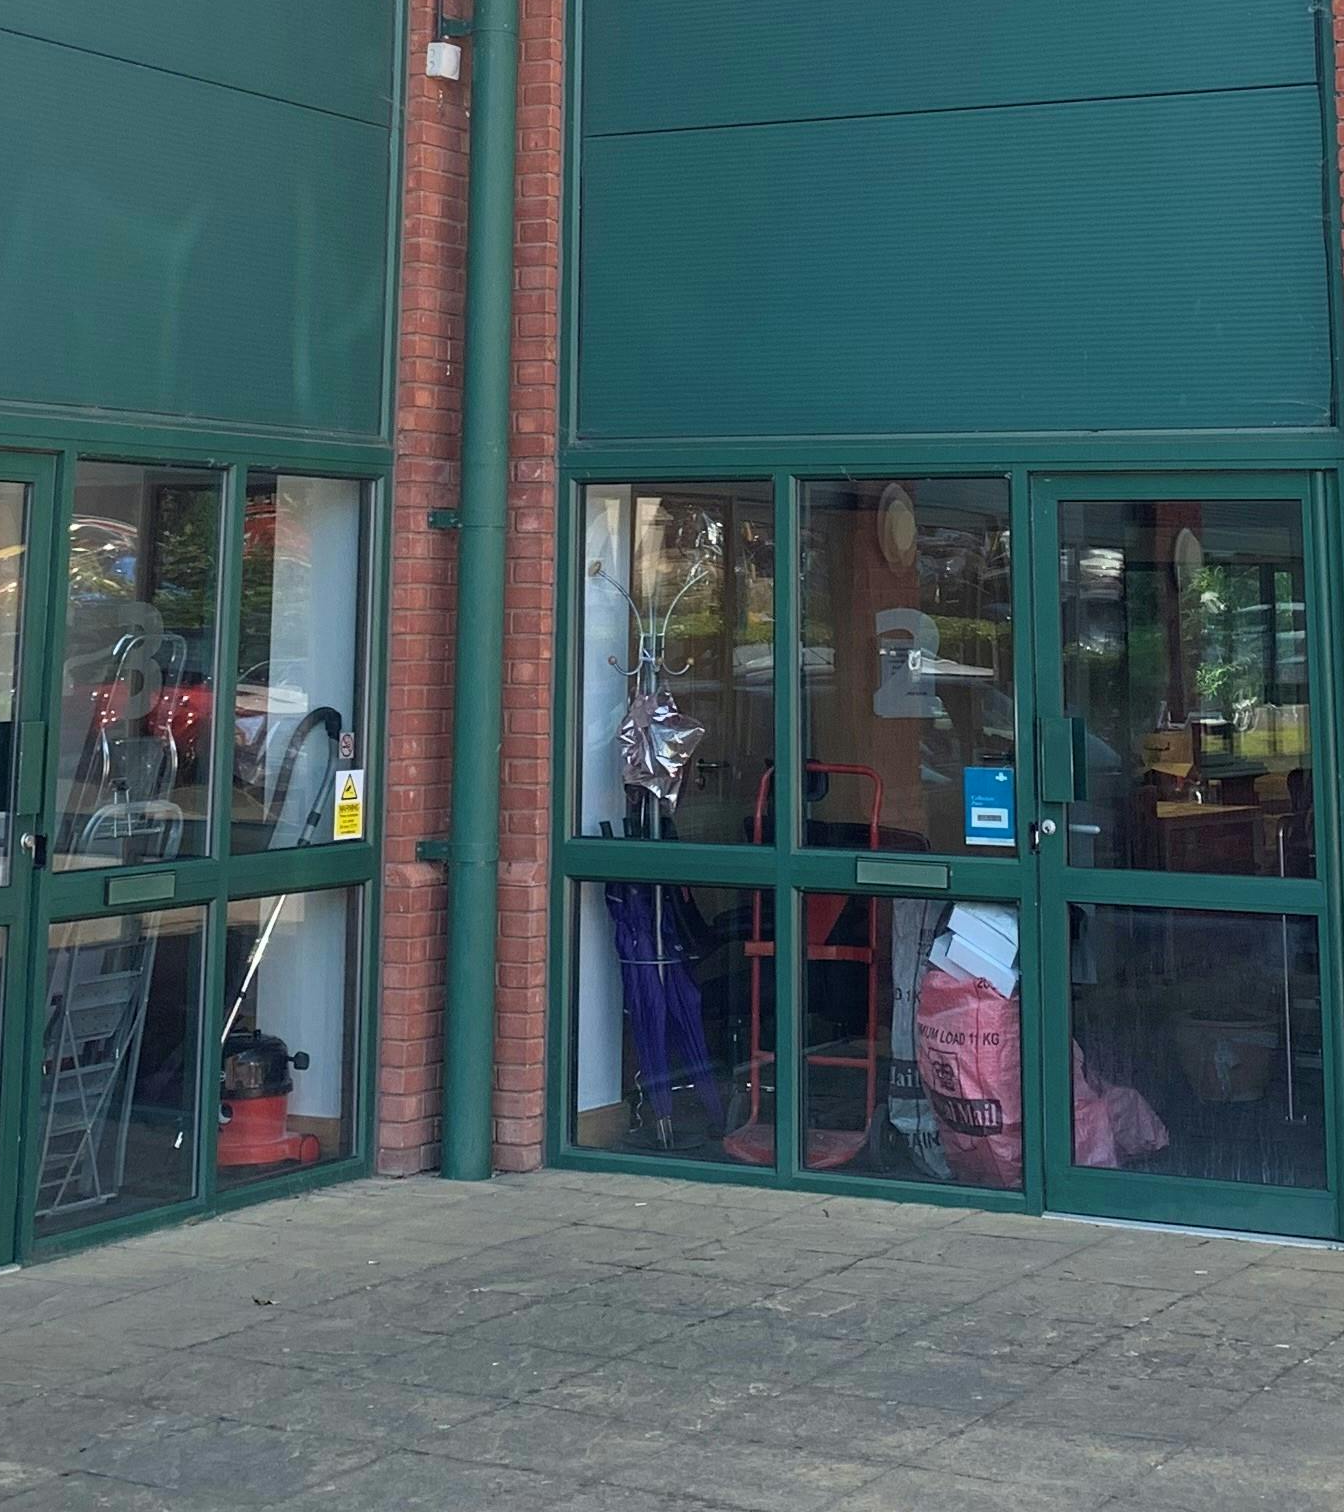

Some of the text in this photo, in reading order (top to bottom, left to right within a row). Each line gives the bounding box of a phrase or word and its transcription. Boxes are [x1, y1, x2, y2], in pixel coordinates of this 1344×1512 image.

[873, 608, 941, 719] 2
[939, 1030, 966, 1046] LOAD
[982, 1032, 1000, 1046] KG
[956, 1102, 998, 1127] Mail
